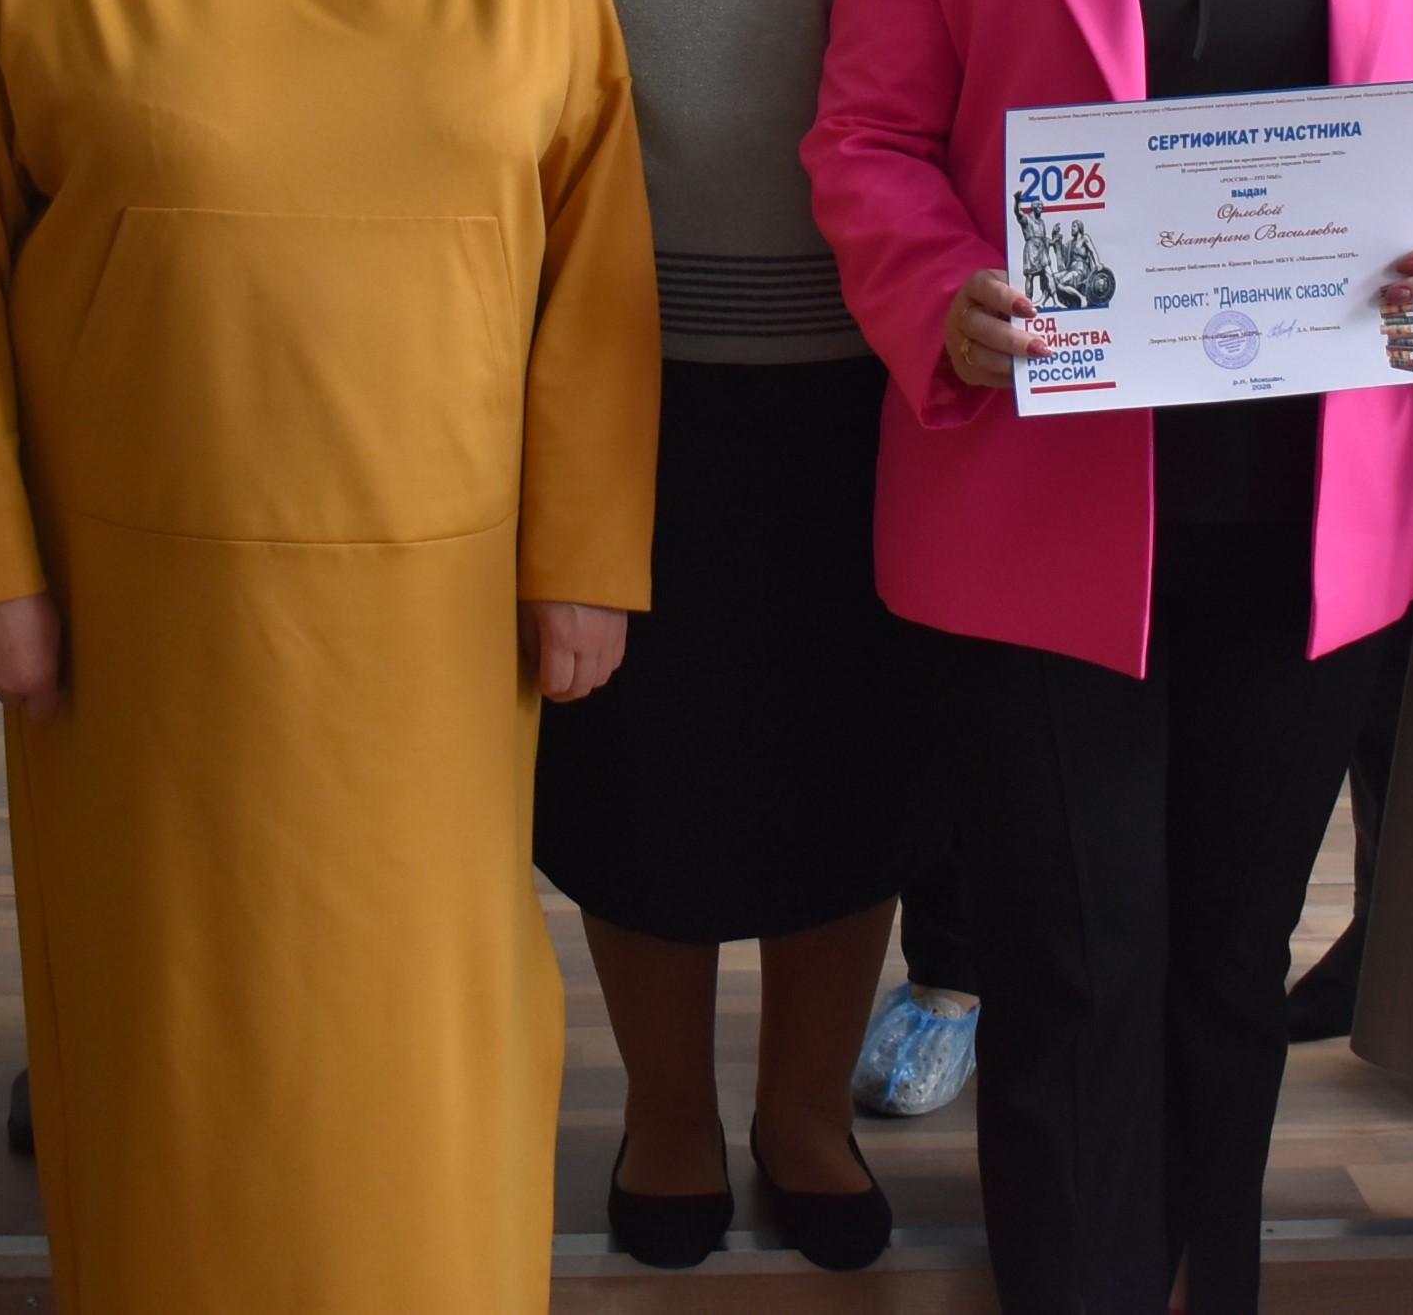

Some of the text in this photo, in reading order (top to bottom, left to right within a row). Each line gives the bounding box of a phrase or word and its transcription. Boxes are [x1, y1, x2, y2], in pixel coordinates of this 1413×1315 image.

[1147, 120, 1362, 151] СЕРТИФИКАТ УЧАСТНИКА
[1018, 162, 1106, 203] 2026
[1230, 186, 1267, 198] выдан
[1216, 202, 1284, 223] Орловой
[1156, 220, 1348, 249] Екатерине Васильевне
[1153, 276, 1349, 313] проект: "Диванчик сказок"
[1024, 316, 1057, 334] ГОД
[1041, 329, 1111, 349] ИНСТВА
[1027, 364, 1096, 383] РОССИИ
